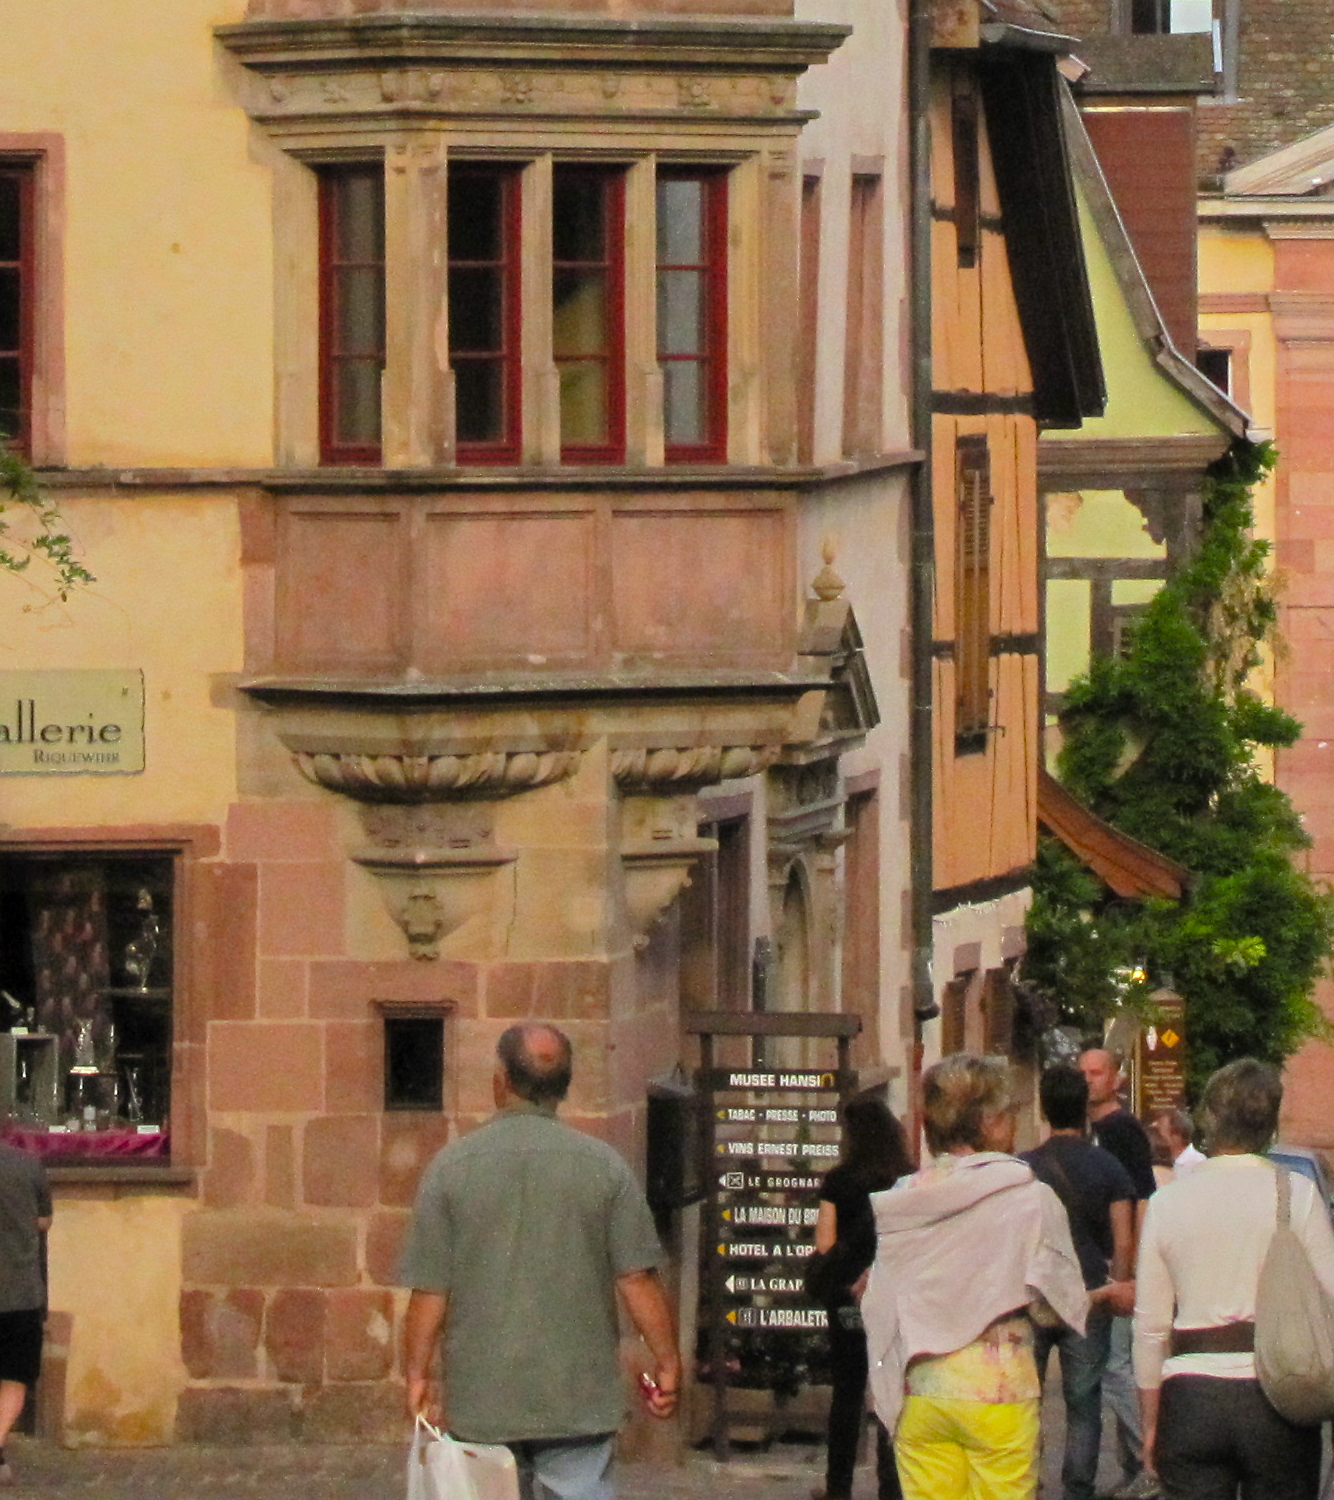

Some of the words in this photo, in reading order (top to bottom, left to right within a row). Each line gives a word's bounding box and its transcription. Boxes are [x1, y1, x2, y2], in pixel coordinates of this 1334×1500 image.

[729, 1073, 775, 1086] MUSEE
[727, 1108, 756, 1120] TABAC
[765, 1109, 799, 1122] PRESSE
[808, 1110, 837, 1122] PHOTO
[727, 1143, 755, 1155] VINS
[757, 1143, 798, 1155] ERNEST
[801, 1145, 839, 1156] PREISS
[748, 1177, 760, 1187] LE
[734, 1206, 747, 1224] LA
[729, 1244, 768, 1256] HOTEL
[751, 1278, 766, 1290] LA
